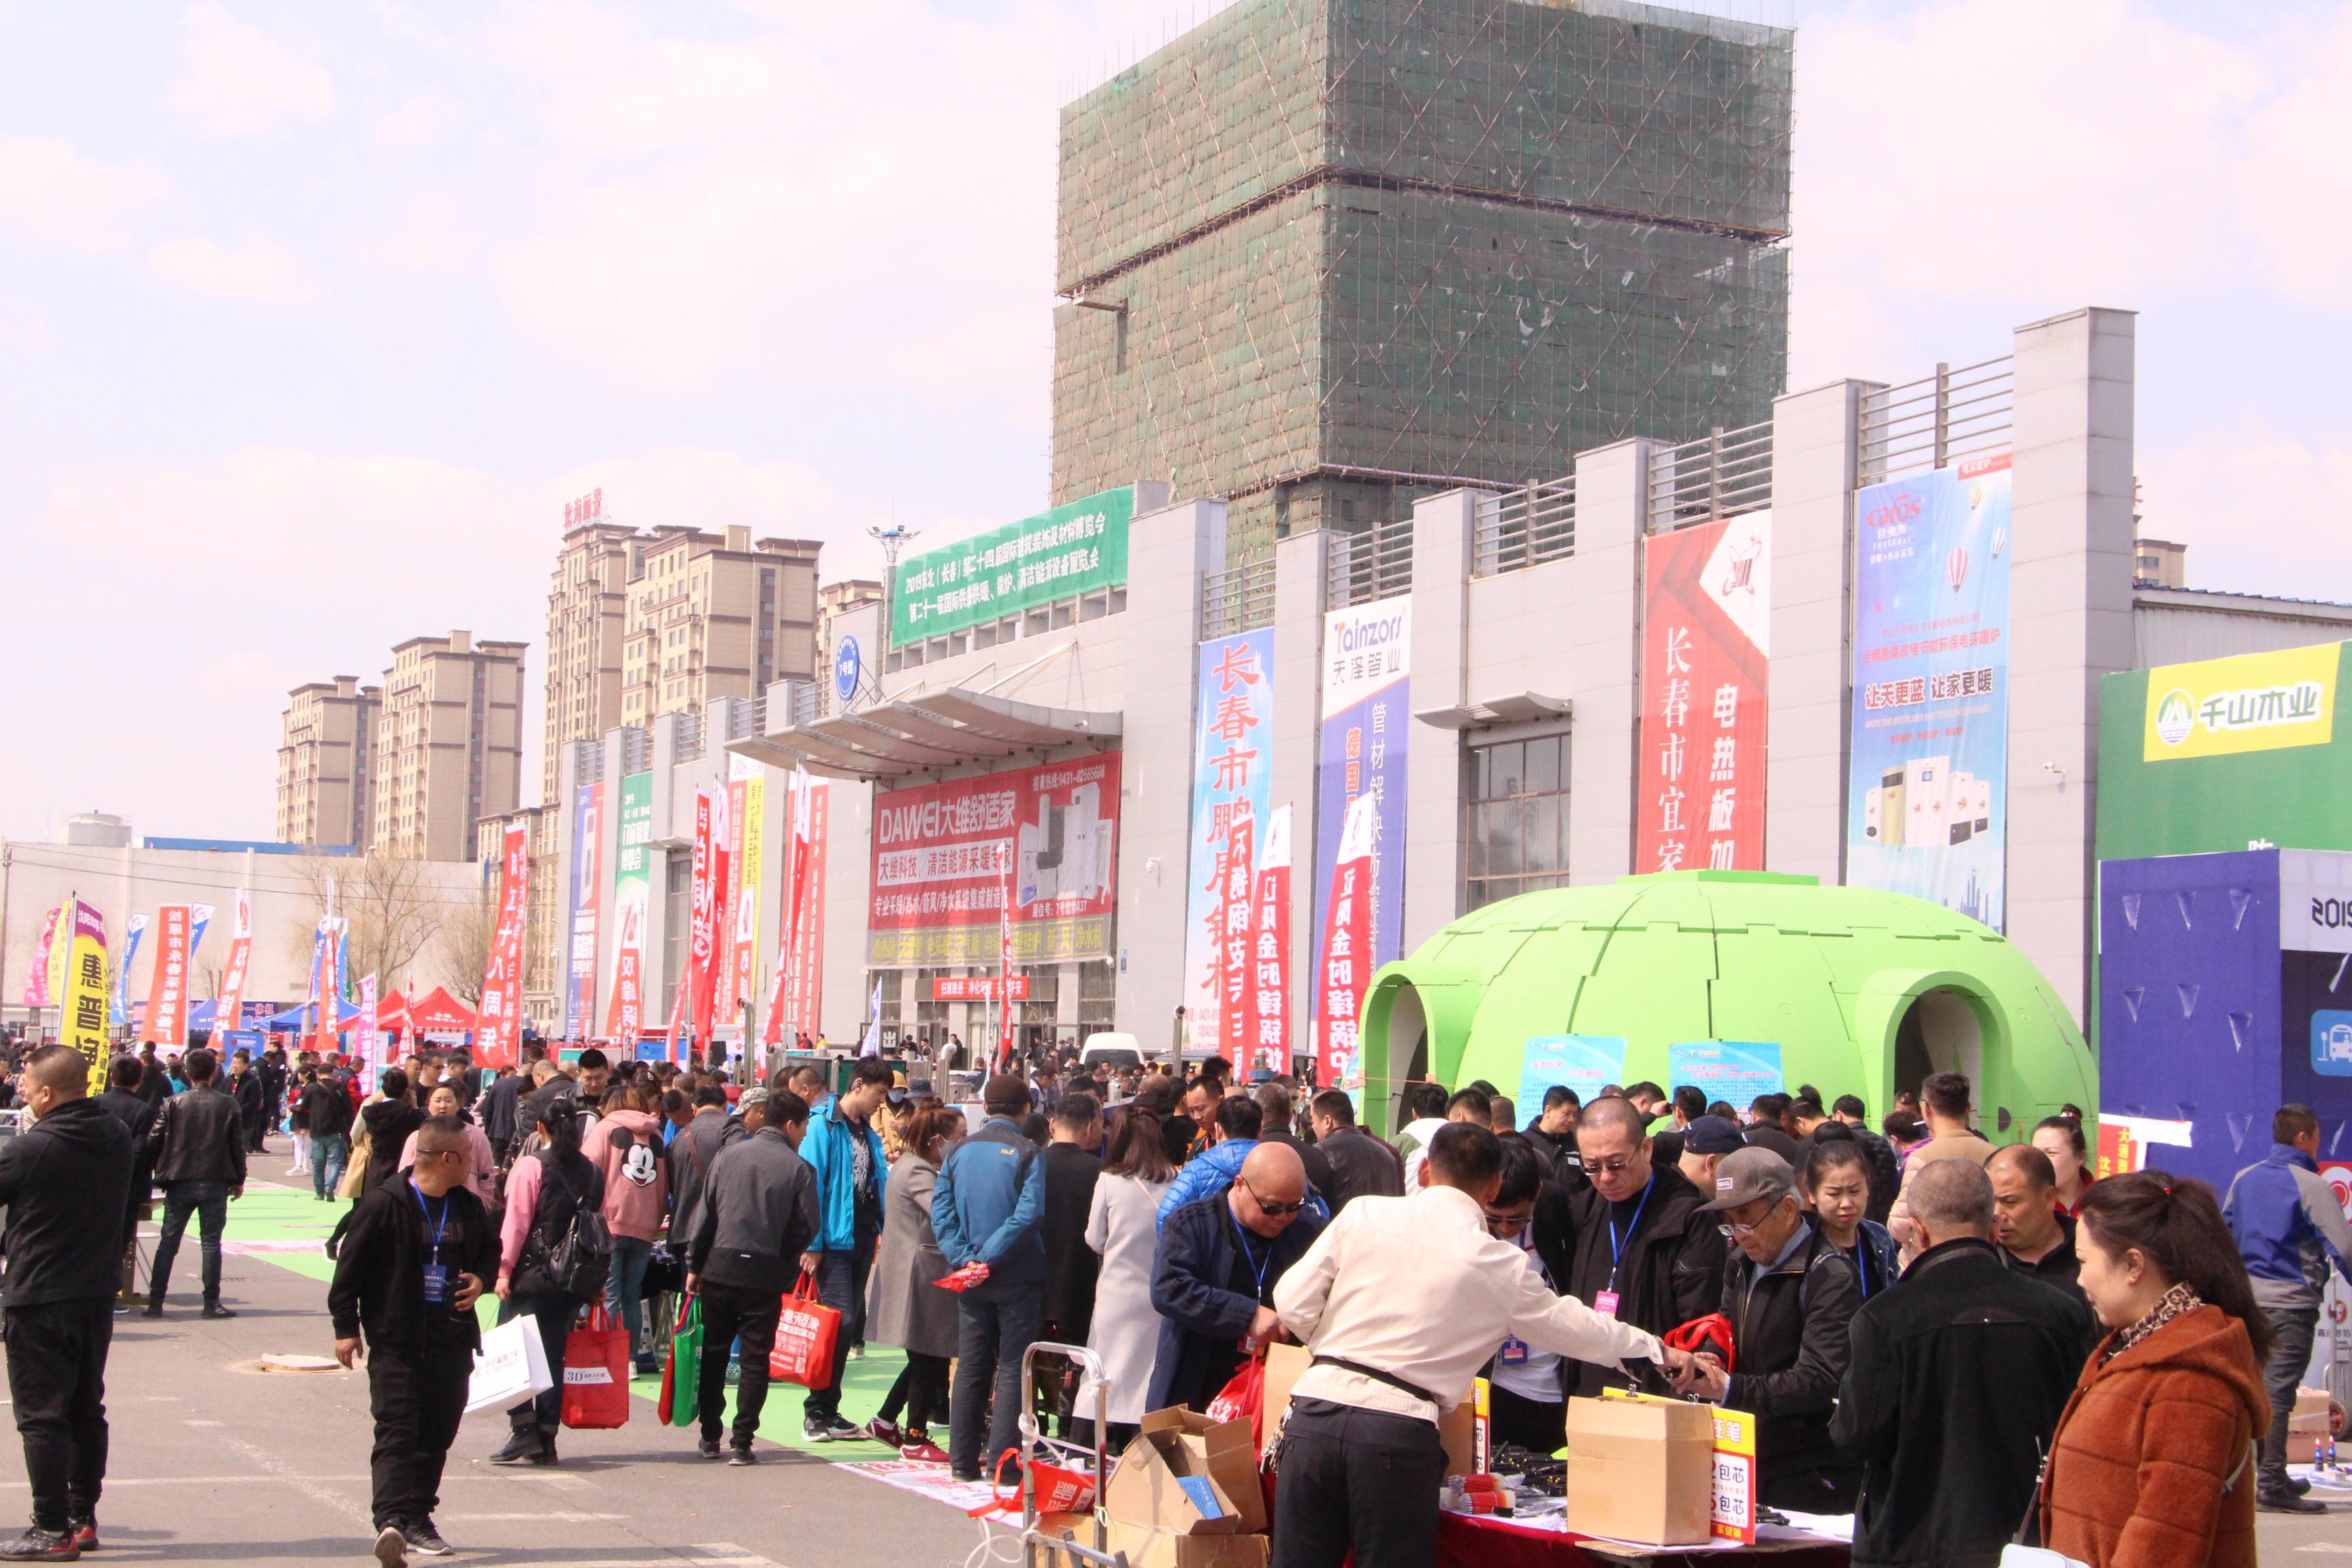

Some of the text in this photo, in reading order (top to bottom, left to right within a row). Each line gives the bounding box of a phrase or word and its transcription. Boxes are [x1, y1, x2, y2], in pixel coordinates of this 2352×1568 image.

[1333, 648, 1401, 686] 天泽管业
[1865, 666, 1993, 709] 让天更蓝 让家更暖
[882, 1031, 896, 1048] 出
